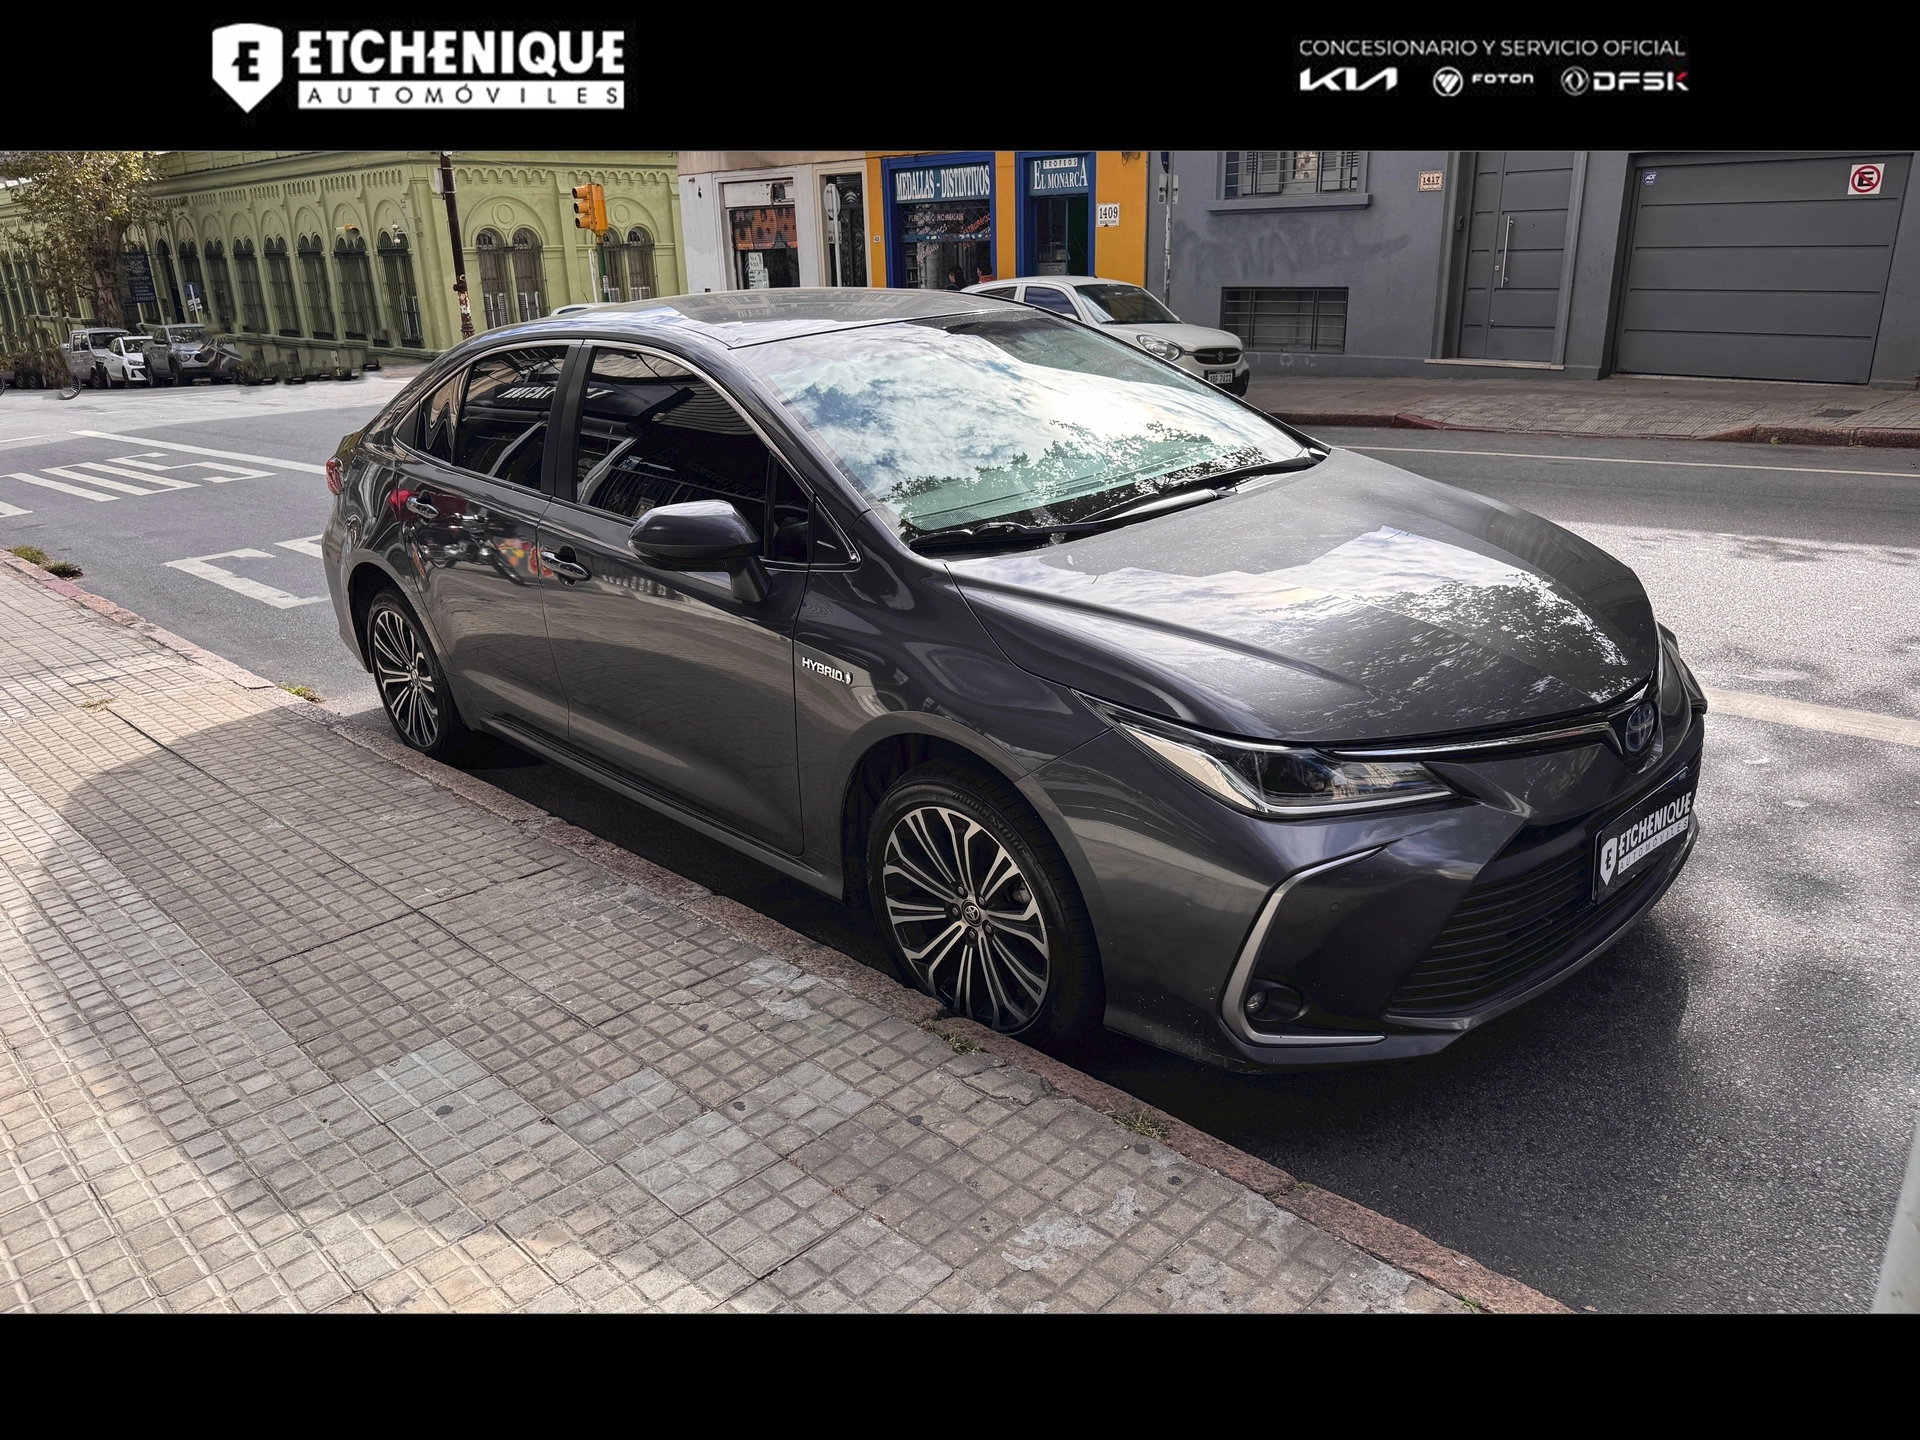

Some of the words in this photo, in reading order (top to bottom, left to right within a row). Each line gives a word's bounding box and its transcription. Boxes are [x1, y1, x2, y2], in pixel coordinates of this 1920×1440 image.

[1044, 158, 1077, 167] TROFEOS
[1047, 157, 1088, 189] MONARCA
[895, 169, 934, 200] MEDALLAS
[940, 165, 990, 198] DISTINTIVOS
[1099, 206, 1118, 219] 1409
[802, 657, 844, 682] HYBRID
[1618, 791, 1692, 857] ETCHENIQUE
